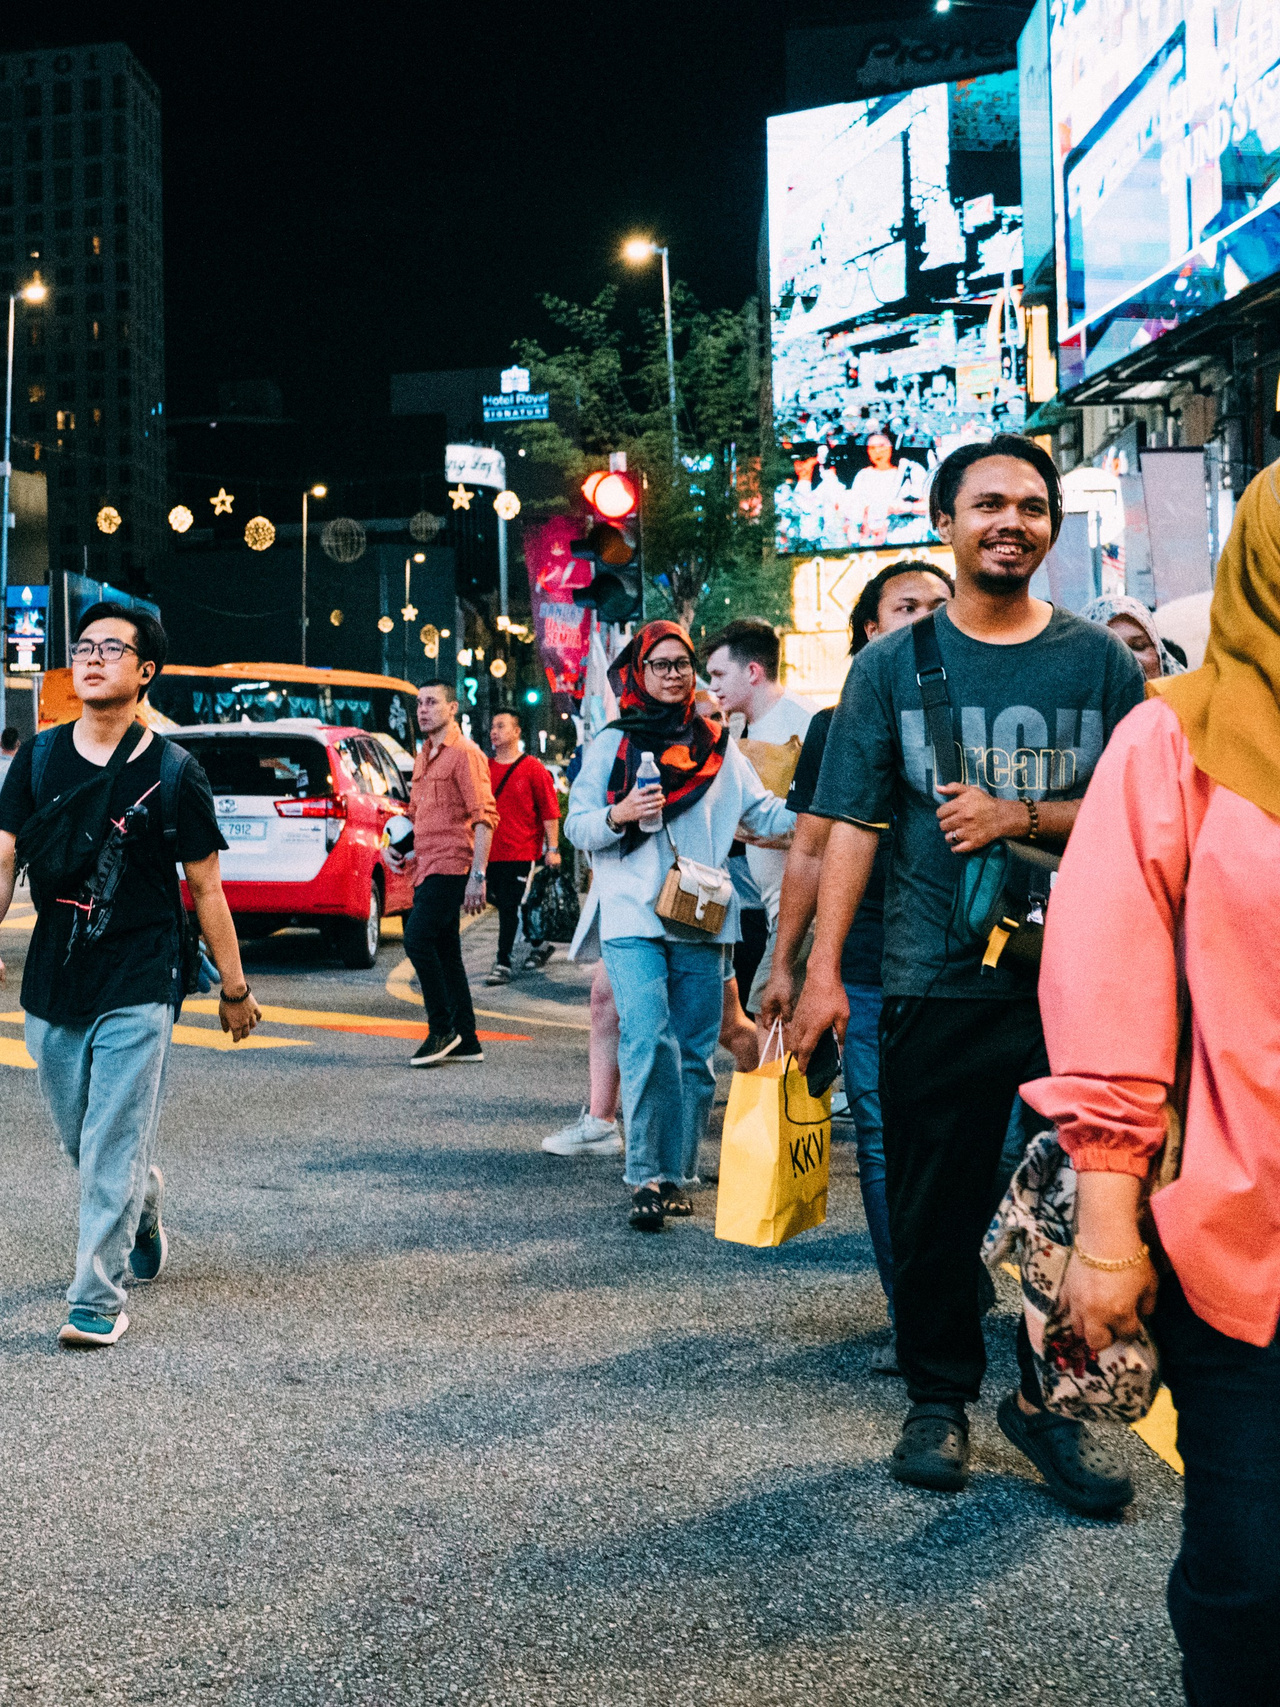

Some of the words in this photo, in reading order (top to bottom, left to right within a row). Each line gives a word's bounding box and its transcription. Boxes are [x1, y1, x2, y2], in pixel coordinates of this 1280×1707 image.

[482, 394, 514, 406] Hotel
[932, 740, 1077, 790] Dream
[228, 822, 252, 836] 7912
[788, 1128, 824, 1179] KKV
